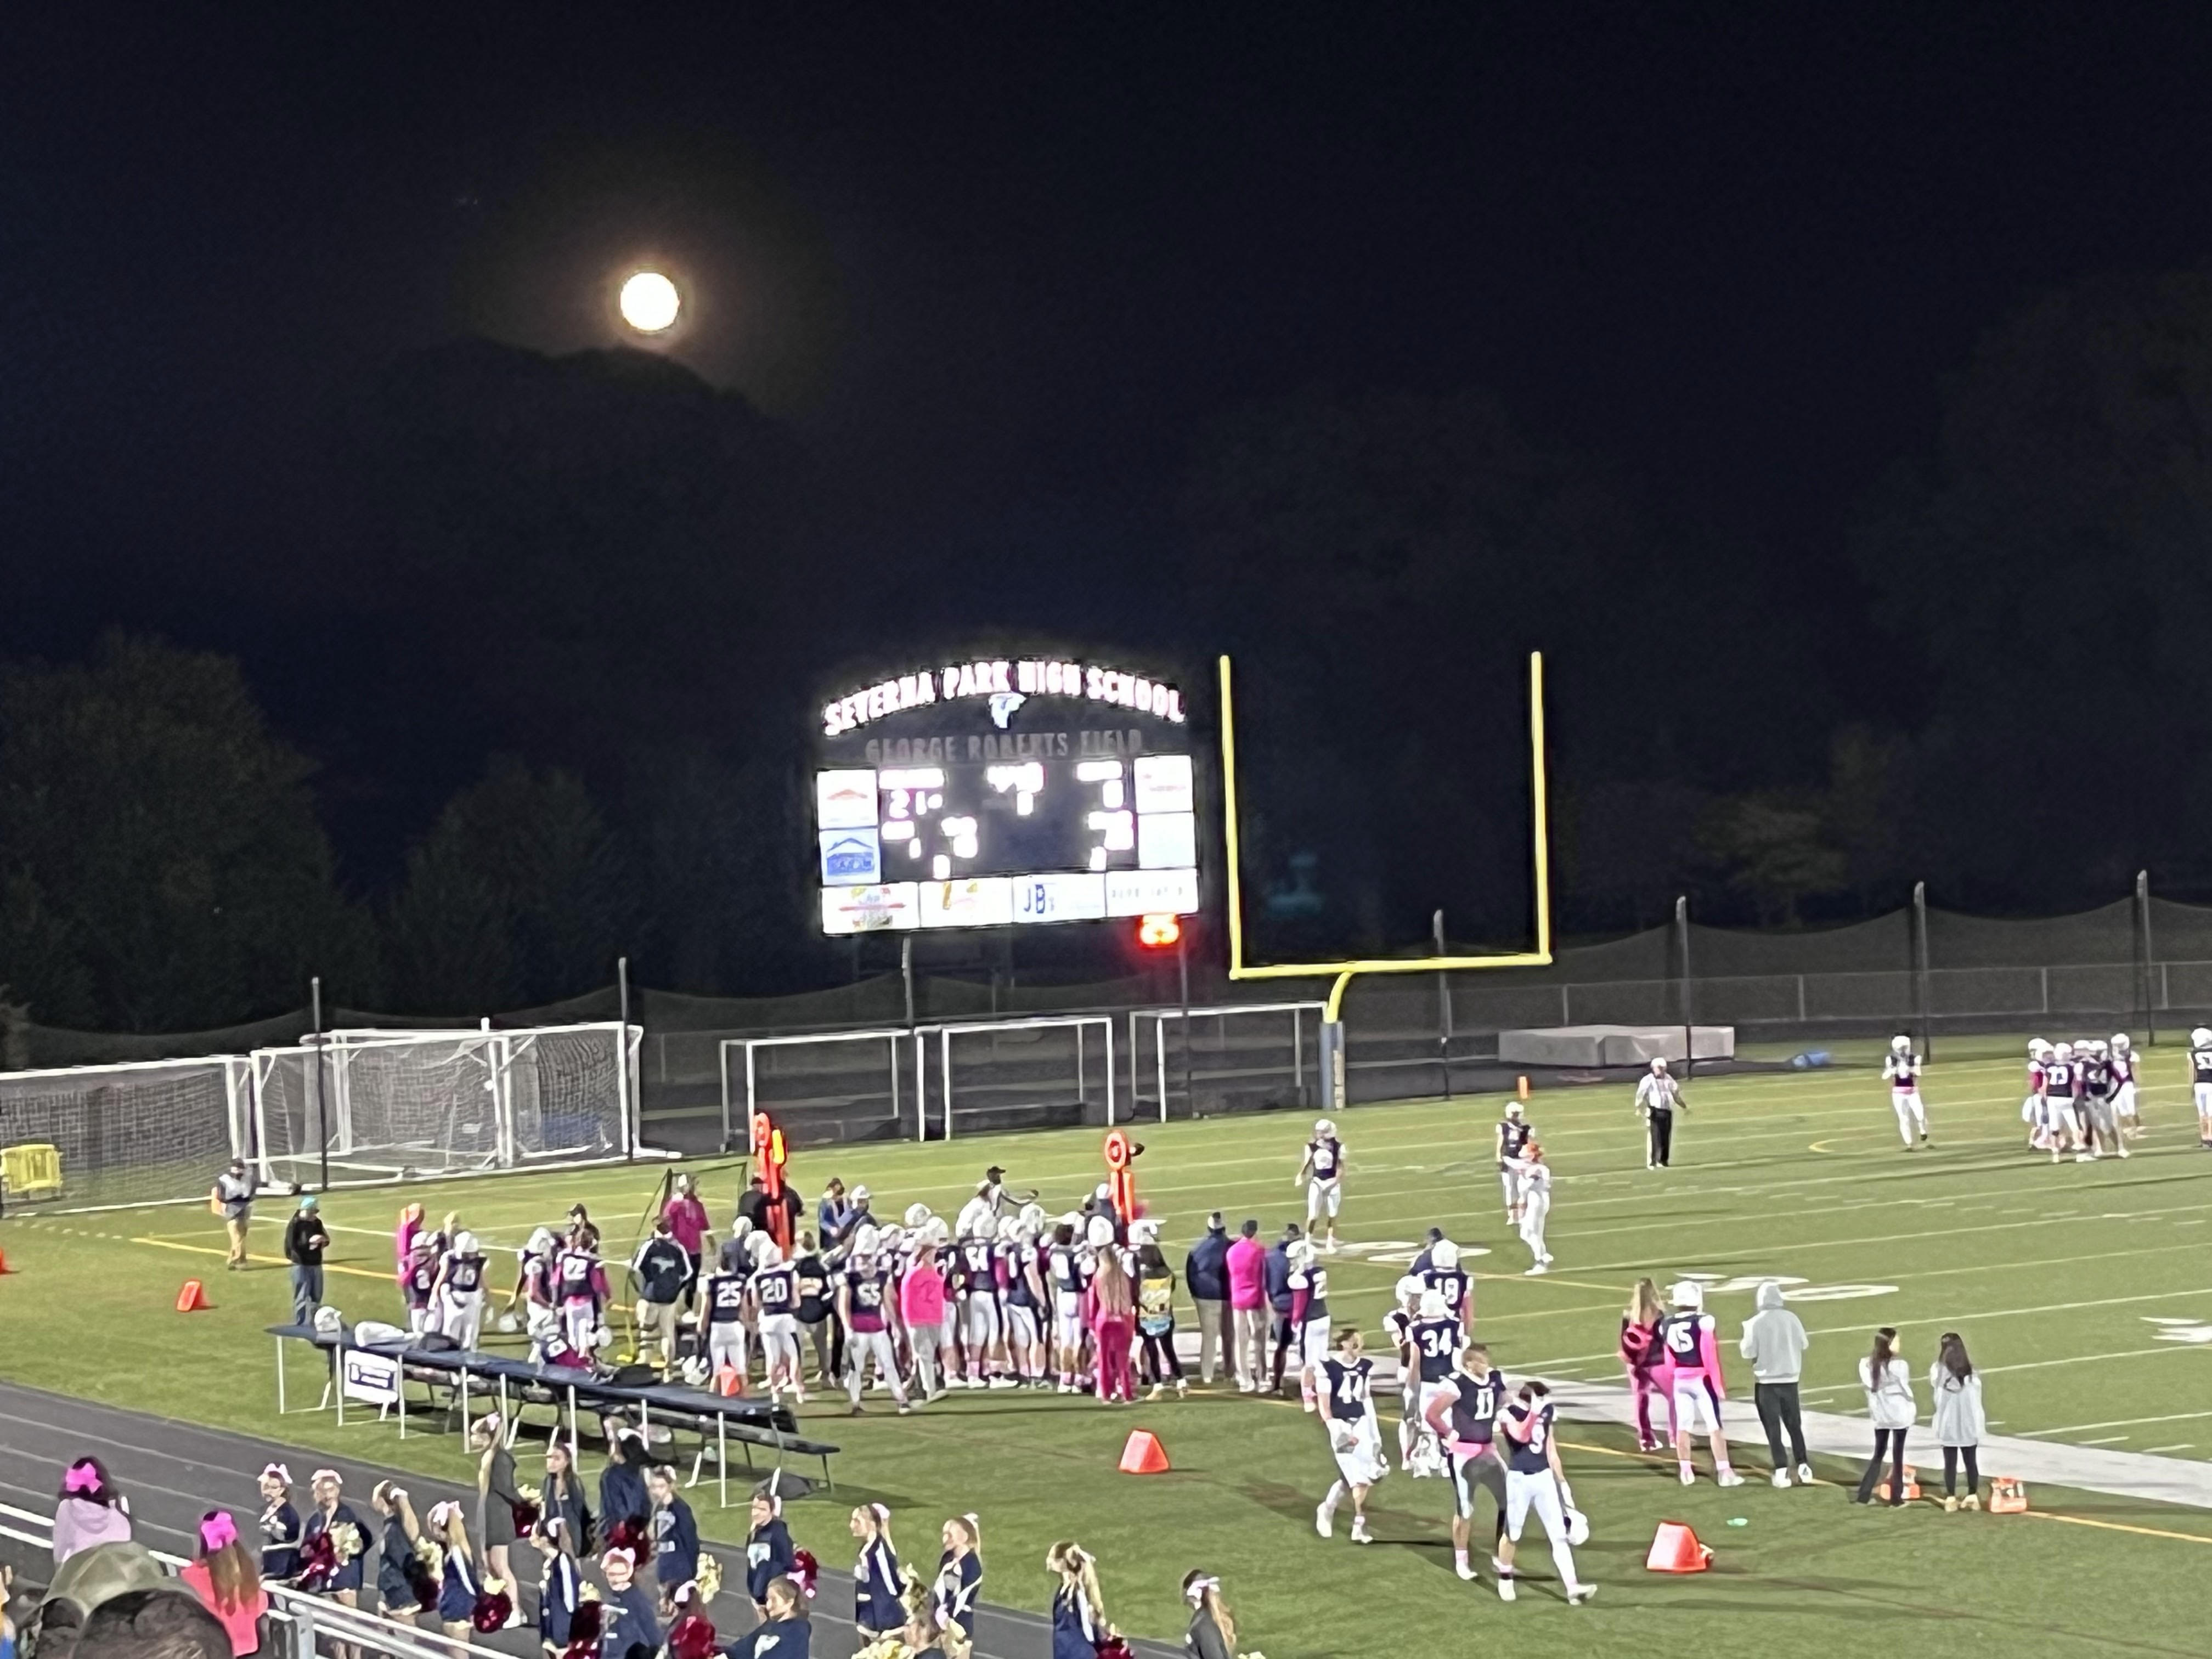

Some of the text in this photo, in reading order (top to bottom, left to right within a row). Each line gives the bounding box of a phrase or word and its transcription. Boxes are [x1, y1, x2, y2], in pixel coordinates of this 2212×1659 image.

[823, 660, 1186, 736] SEVERNA PARK HIGH SCHOOL
[865, 736, 960, 763] GEORGE
[1080, 729, 1142, 757] FIELD
[760, 1277, 788, 1303] 20
[1421, 1328, 1452, 1357] 34
